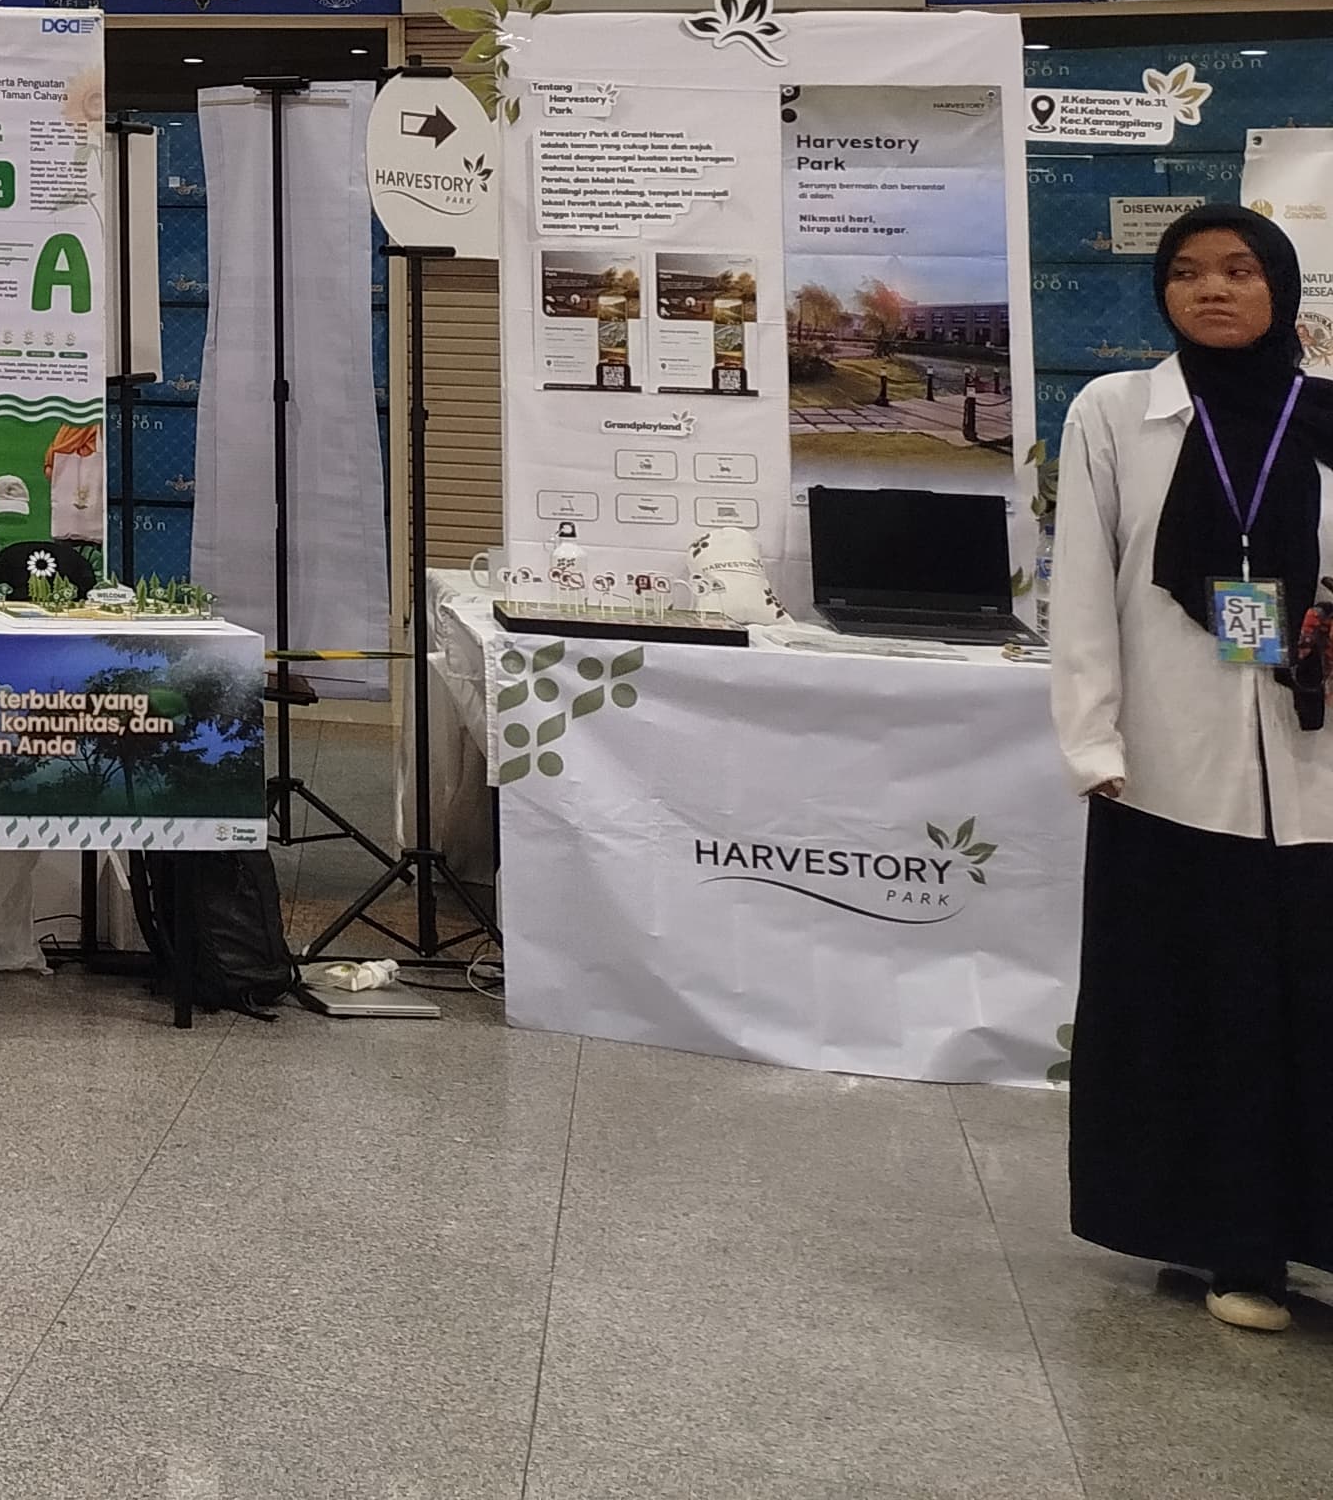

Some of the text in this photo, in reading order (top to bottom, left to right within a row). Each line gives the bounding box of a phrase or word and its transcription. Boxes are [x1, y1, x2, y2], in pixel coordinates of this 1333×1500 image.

[1199, 57, 1263, 70] soon
[17, 78, 65, 89] Penguatan
[532, 82, 573, 93] Tentang
[1, 91, 32, 100] Taman
[33, 91, 68, 102] Cahaya
[549, 94, 608, 105] Harvestory
[1060, 95, 1120, 106] Jl.Kebraon
[1123, 97, 1133, 106] V
[549, 106, 574, 115] Park
[1060, 116, 1163, 130] Kec.Karangpilang
[796, 134, 919, 154] Harvestory
[797, 156, 845, 171] Park
[375, 167, 475, 193] HARVESTORY
[798, 182, 945, 191] Serunya bermain dan bersantai
[445, 195, 474, 206] PARK
[799, 214, 845, 223] Nikmati
[799, 225, 909, 236] hirup udara segar.
[31, 232, 92, 314] A
[604, 420, 682, 432] Grandplayland
[97, 592, 127, 600] WELCOME
[0, 690, 88, 710] terbuka
[90, 692, 149, 715] yang
[0, 713, 125, 737] komunitas,
[129, 713, 174, 734] dan
[16, 737, 77, 756] Anda
[694, 839, 952, 885] HARVESTORY
[886, 889, 951, 907] PARK
